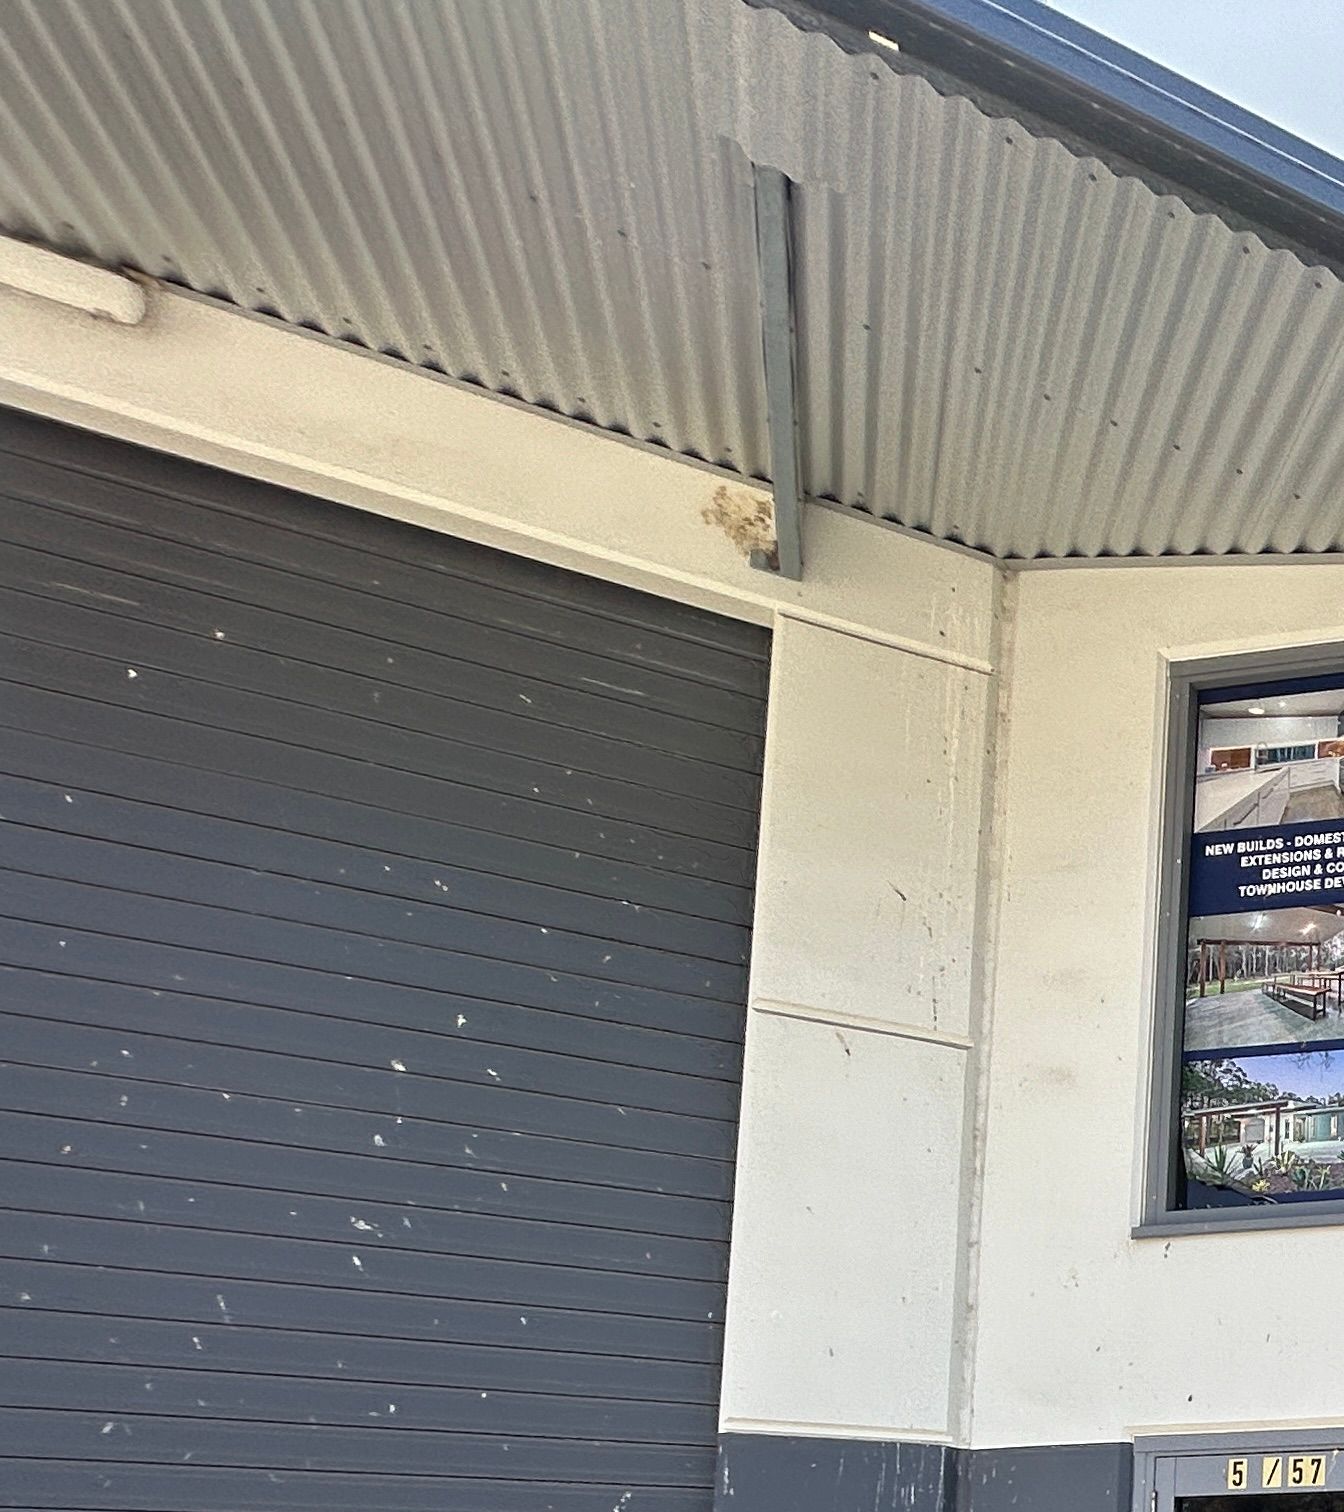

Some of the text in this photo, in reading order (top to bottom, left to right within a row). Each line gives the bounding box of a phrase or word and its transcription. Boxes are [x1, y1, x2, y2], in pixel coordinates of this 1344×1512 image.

[1205, 843, 1234, 856] NEW
[1237, 838, 1284, 854] BUILDS
[1240, 849, 1321, 868] EXTENSIONS
[1324, 849, 1333, 858] &
[1262, 865, 1310, 880] DESIGN
[1314, 864, 1323, 875] &
[1238, 879, 1322, 898] TOWNHOUSE
[1232, 1461, 1244, 1486] 5
